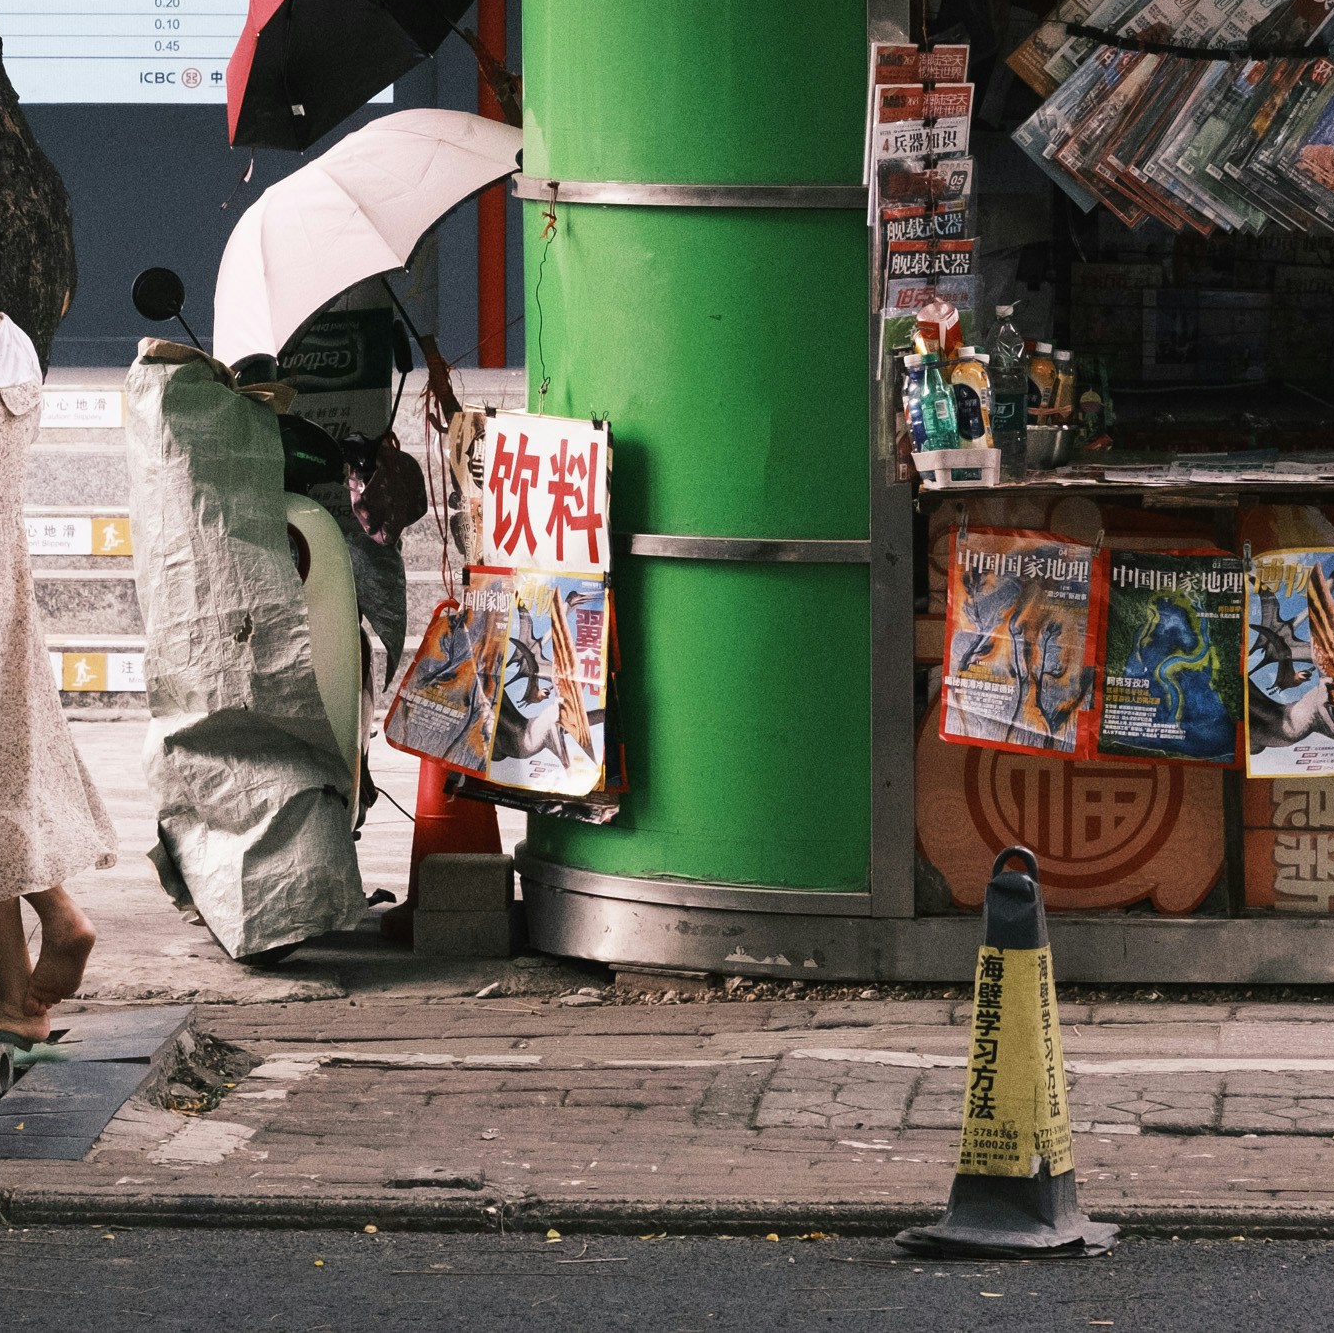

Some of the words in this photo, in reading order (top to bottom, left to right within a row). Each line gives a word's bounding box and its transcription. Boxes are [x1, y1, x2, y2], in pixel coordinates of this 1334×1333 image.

[155, 19, 180, 30] 0.10
[155, 41, 180, 52] 0.45
[140, 72, 176, 84] ICBC
[211, 71, 223, 84] 中
[893, 130, 957, 154] 兵器知识
[891, 252, 970, 275] 舰载武器
[489, 432, 604, 564] 饮料
[957, 549, 1089, 583] 中国国家地理
[1112, 564, 1244, 594] 中国国家地理
[1254, 558, 1314, 598] 博物
[461, 586, 511, 616] 国国家地
[968, 954, 1005, 1121] 海壁学习方法
[961, 1139, 1018, 1150] 2-3600268
